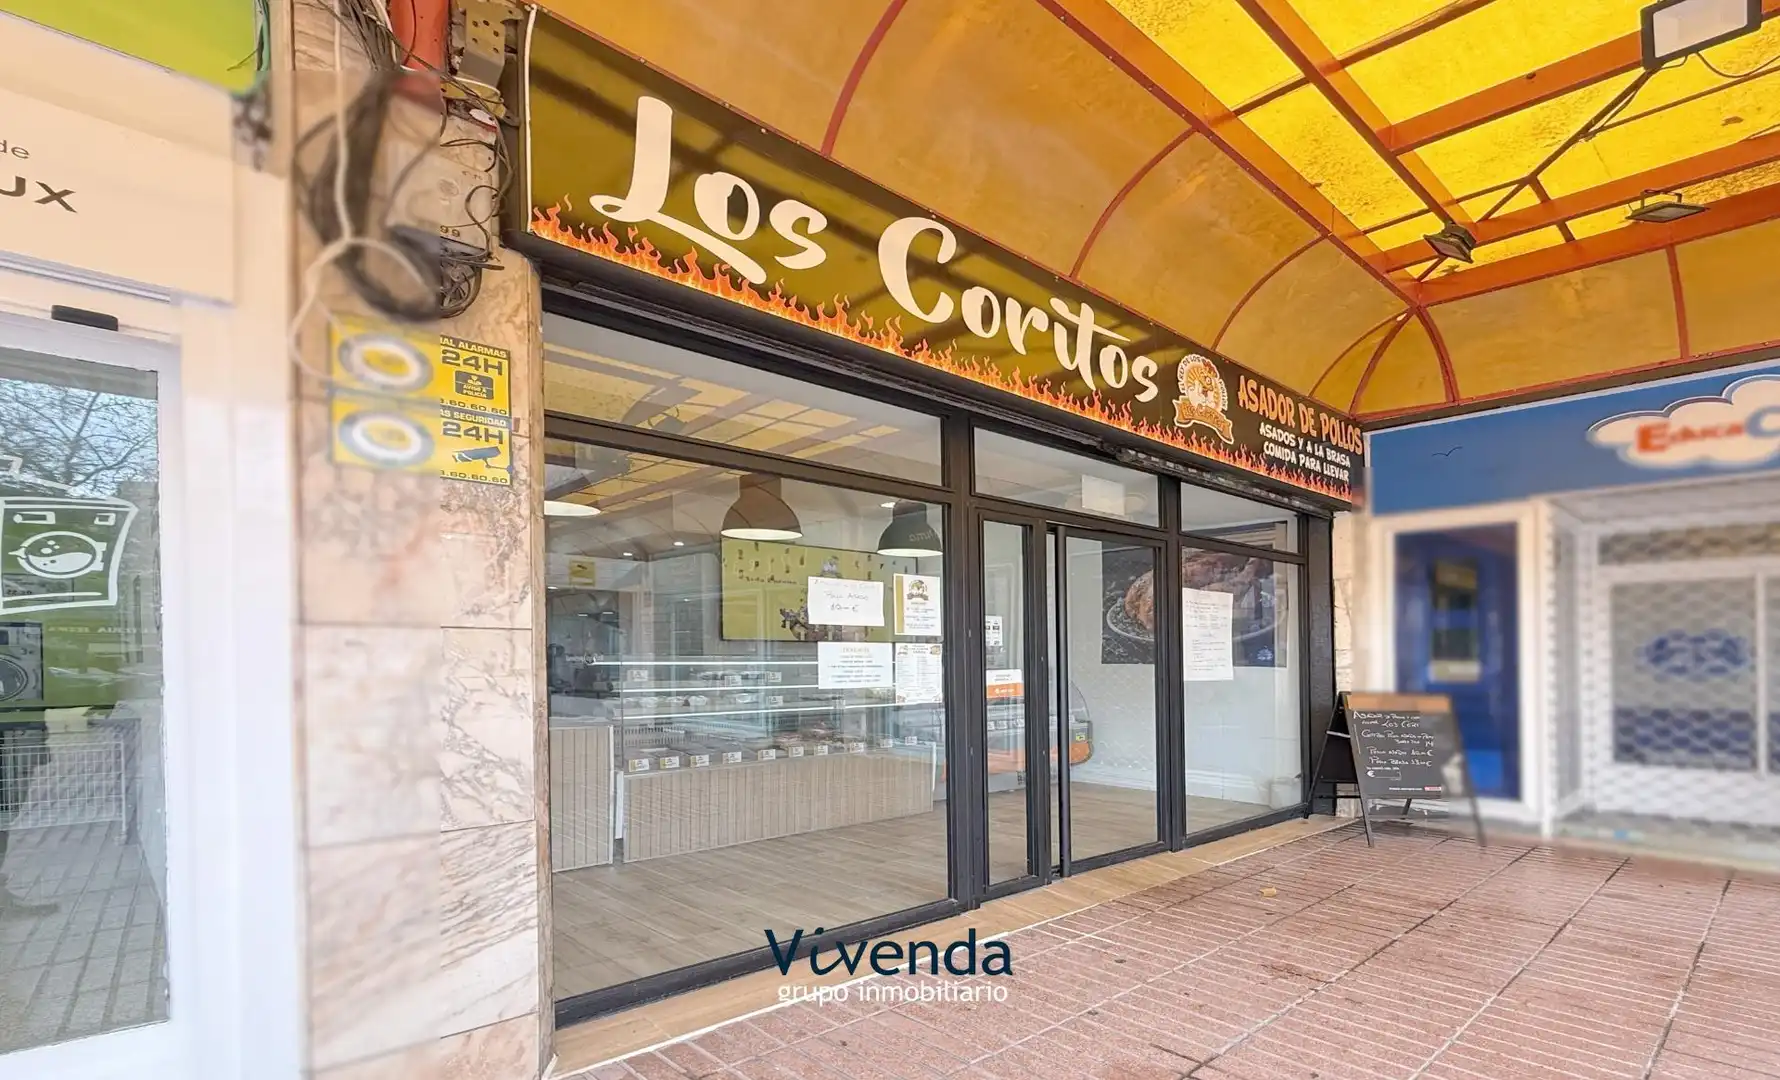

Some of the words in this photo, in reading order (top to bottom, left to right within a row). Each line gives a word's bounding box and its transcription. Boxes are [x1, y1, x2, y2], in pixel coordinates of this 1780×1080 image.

[589, 96, 827, 284] Los
[878, 217, 1158, 402] Coritos
[442, 349, 502, 376] 24H
[458, 341, 506, 358] ALARMAS
[453, 411, 507, 427] SEGURIDAD
[1238, 375, 1296, 428] ASADOR
[1299, 403, 1317, 437] DE
[1320, 412, 1363, 455] POLLOS
[442, 421, 504, 445] 24H
[1260, 422, 1296, 447] ASADOS
[1298, 437, 1304, 451] Y
[1306, 441, 1313, 454] A
[1315, 443, 1325, 458] LA
[1326, 448, 1351, 468] BRASA
[1264, 441, 1297, 464] COMIDA
[1299, 454, 1321, 472] PARA
[1323, 463, 1349, 483] LLEVAR
